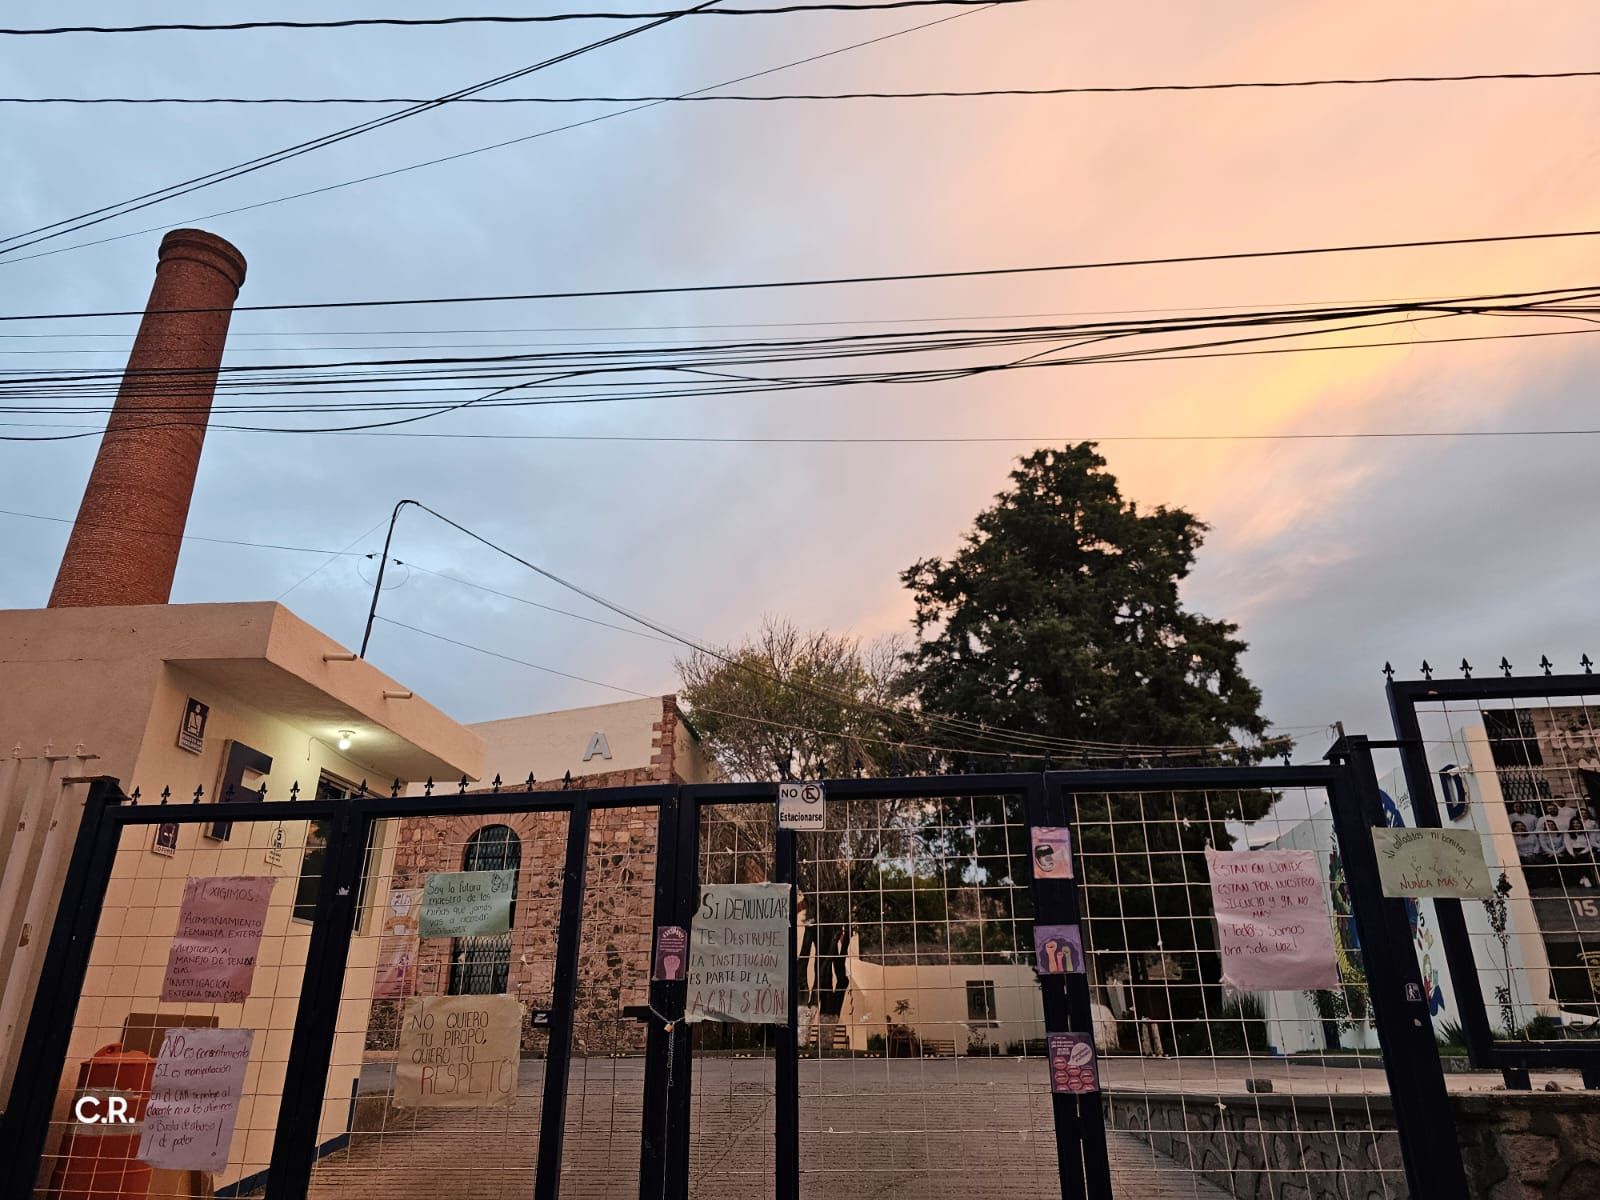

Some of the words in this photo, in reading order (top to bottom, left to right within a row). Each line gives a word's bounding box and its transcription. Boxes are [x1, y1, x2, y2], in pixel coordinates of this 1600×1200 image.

[583, 731, 612, 762] A
[781, 789, 798, 798] NO
[1440, 765, 1469, 821] D
[780, 812, 822, 822] Estacionarse
[427, 880, 444, 895] Soy
[448, 882, 455, 894] la
[459, 880, 481, 893] futura
[1399, 873, 1433, 890] NUNCA
[428, 894, 462, 906] maestra
[466, 893, 476, 903] de
[724, 897, 788, 920] DENUNCIAR
[1573, 899, 1599, 918] 15
[183, 926, 224, 938] FEMINISTA
[696, 928, 716, 945] TE
[175, 956, 209, 966] MANEJO
[211, 956, 224, 966] DE
[691, 954, 704, 967] LA
[689, 973, 701, 985] ES
[706, 971, 735, 985] PARTE
[740, 971, 750, 983] DE
[756, 972, 769, 984] LA
[412, 1000, 435, 1031] NO
[446, 1010, 489, 1029] QUIERO
[161, 1035, 186, 1058] NO
[418, 1033, 433, 1047] TU
[412, 1047, 450, 1064] QUIERO
[458, 1046, 475, 1062] TU
[421, 1058, 513, 1096] RESPETO
